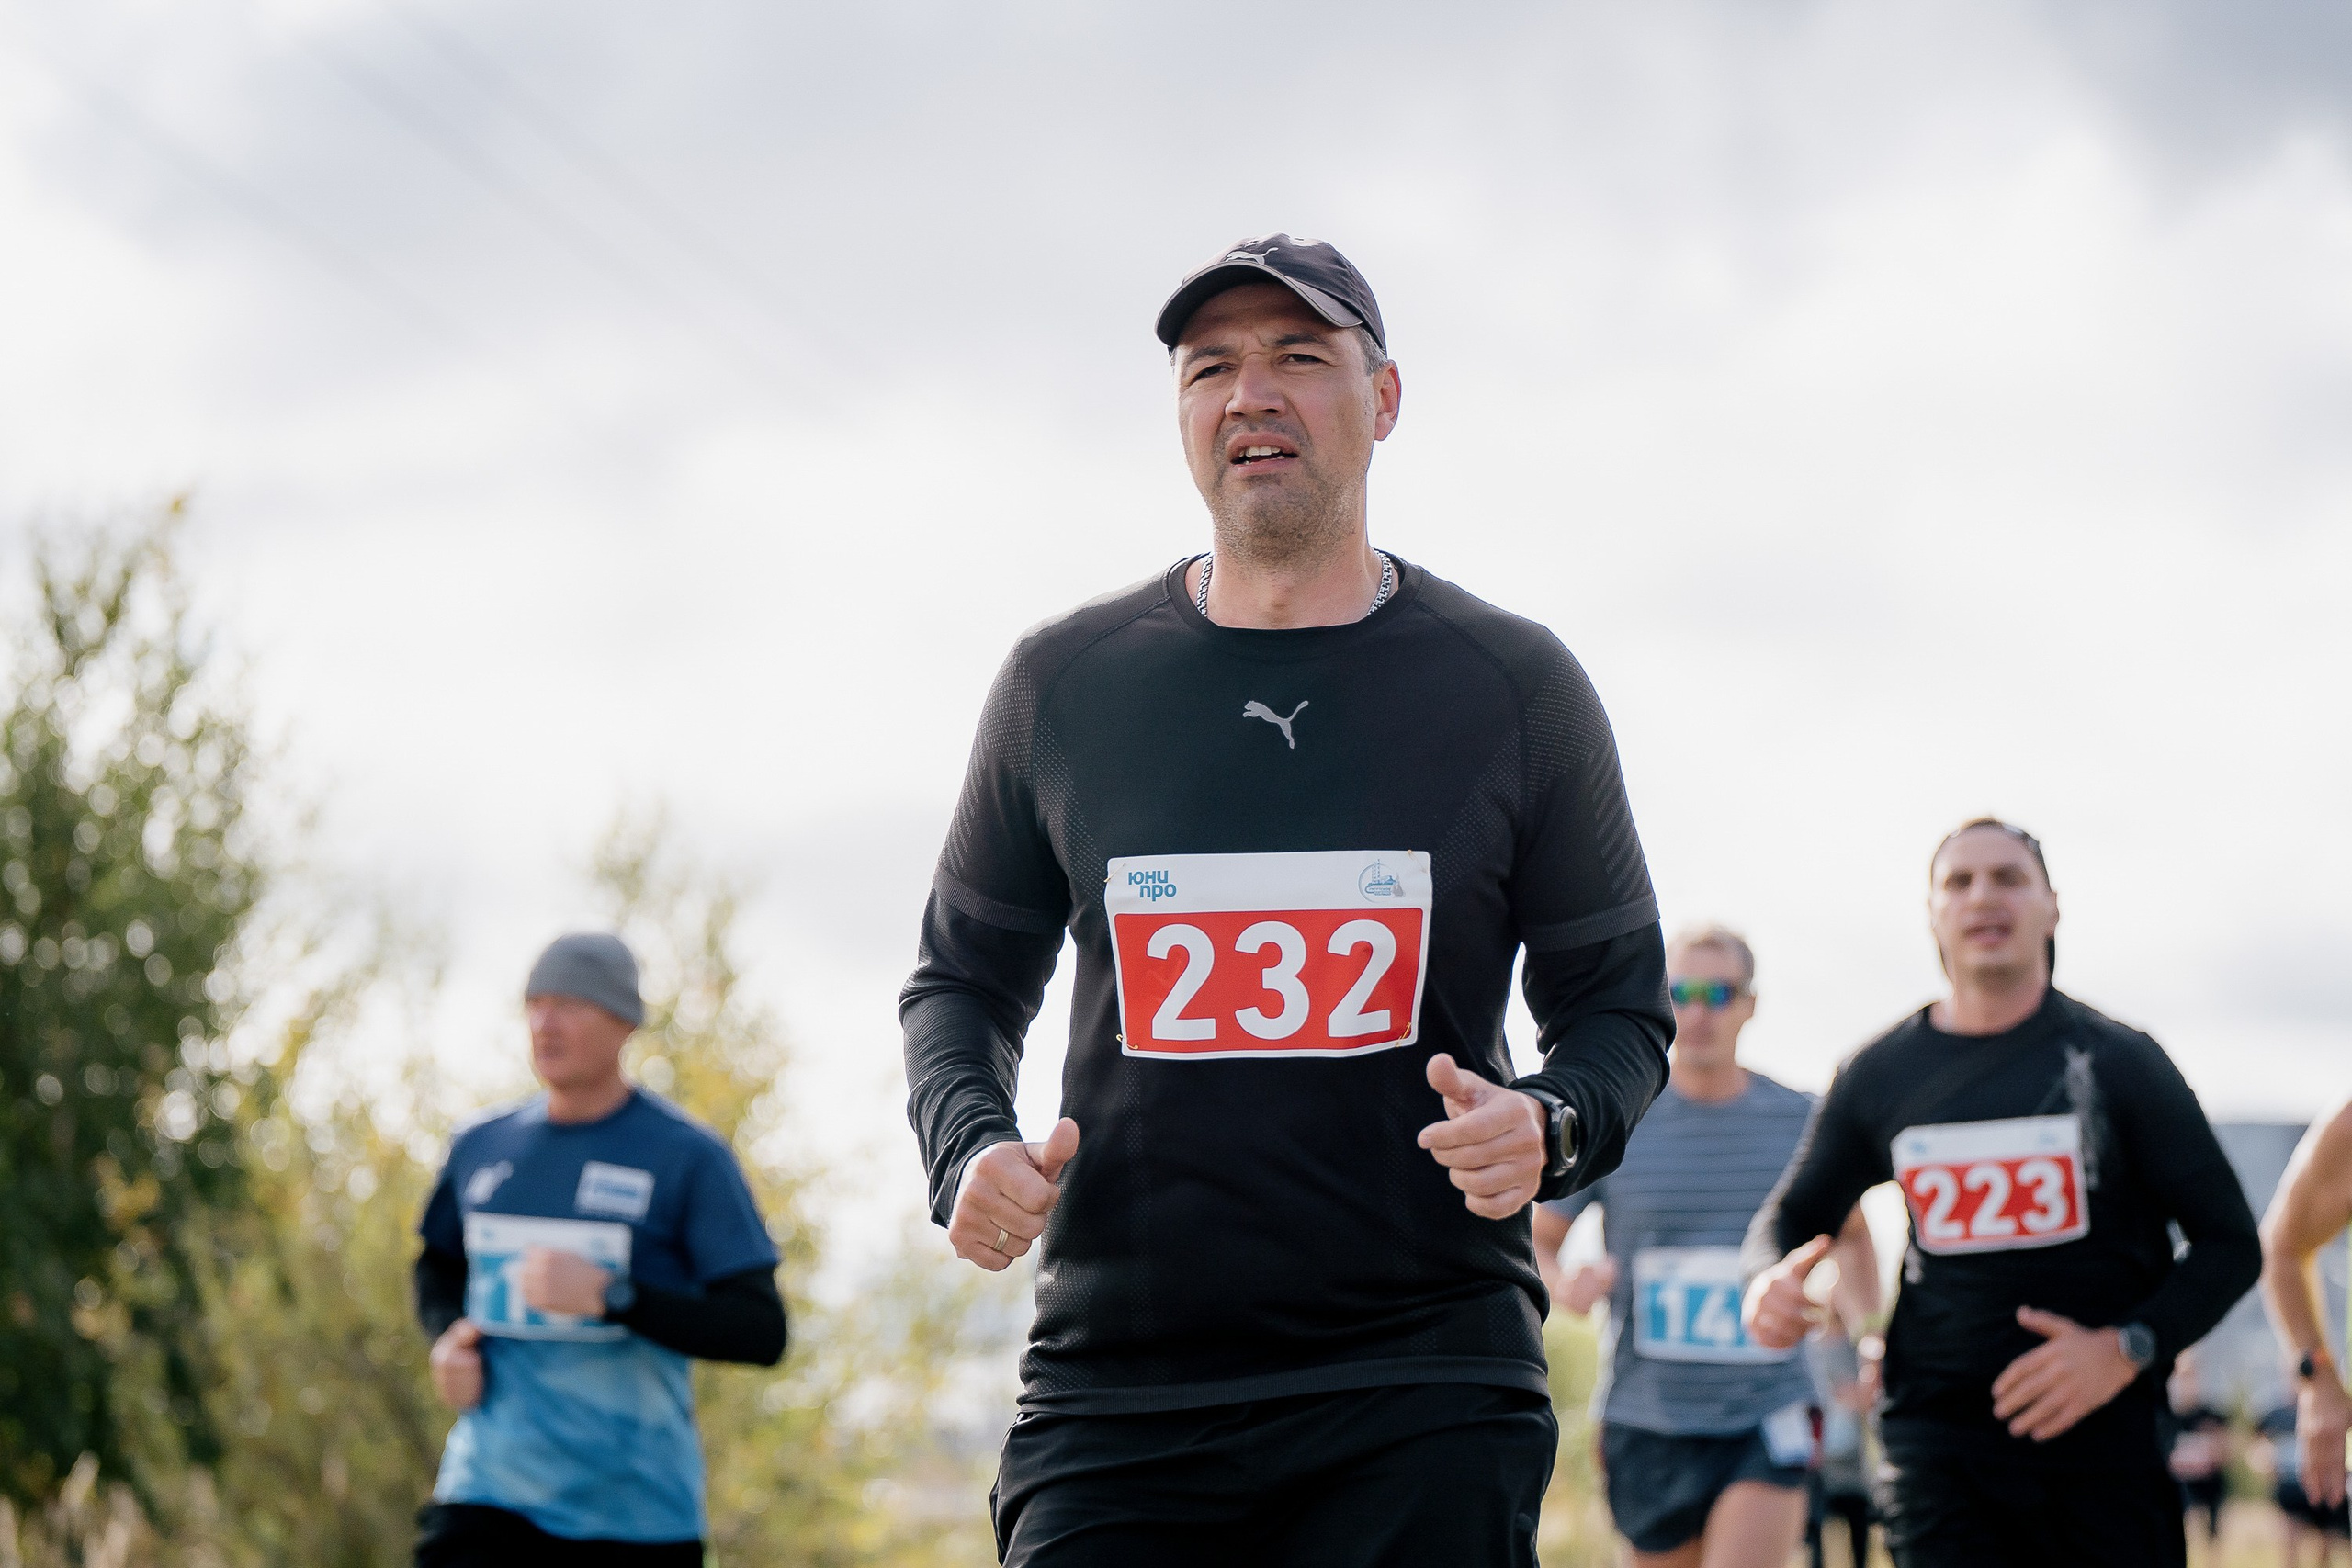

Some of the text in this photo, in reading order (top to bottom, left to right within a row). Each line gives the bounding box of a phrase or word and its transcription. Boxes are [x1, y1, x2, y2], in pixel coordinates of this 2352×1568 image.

[1146, 919, 1397, 1041] 232
[1913, 1159, 2070, 1238] 223
[1657, 1283, 1743, 1341] 14
